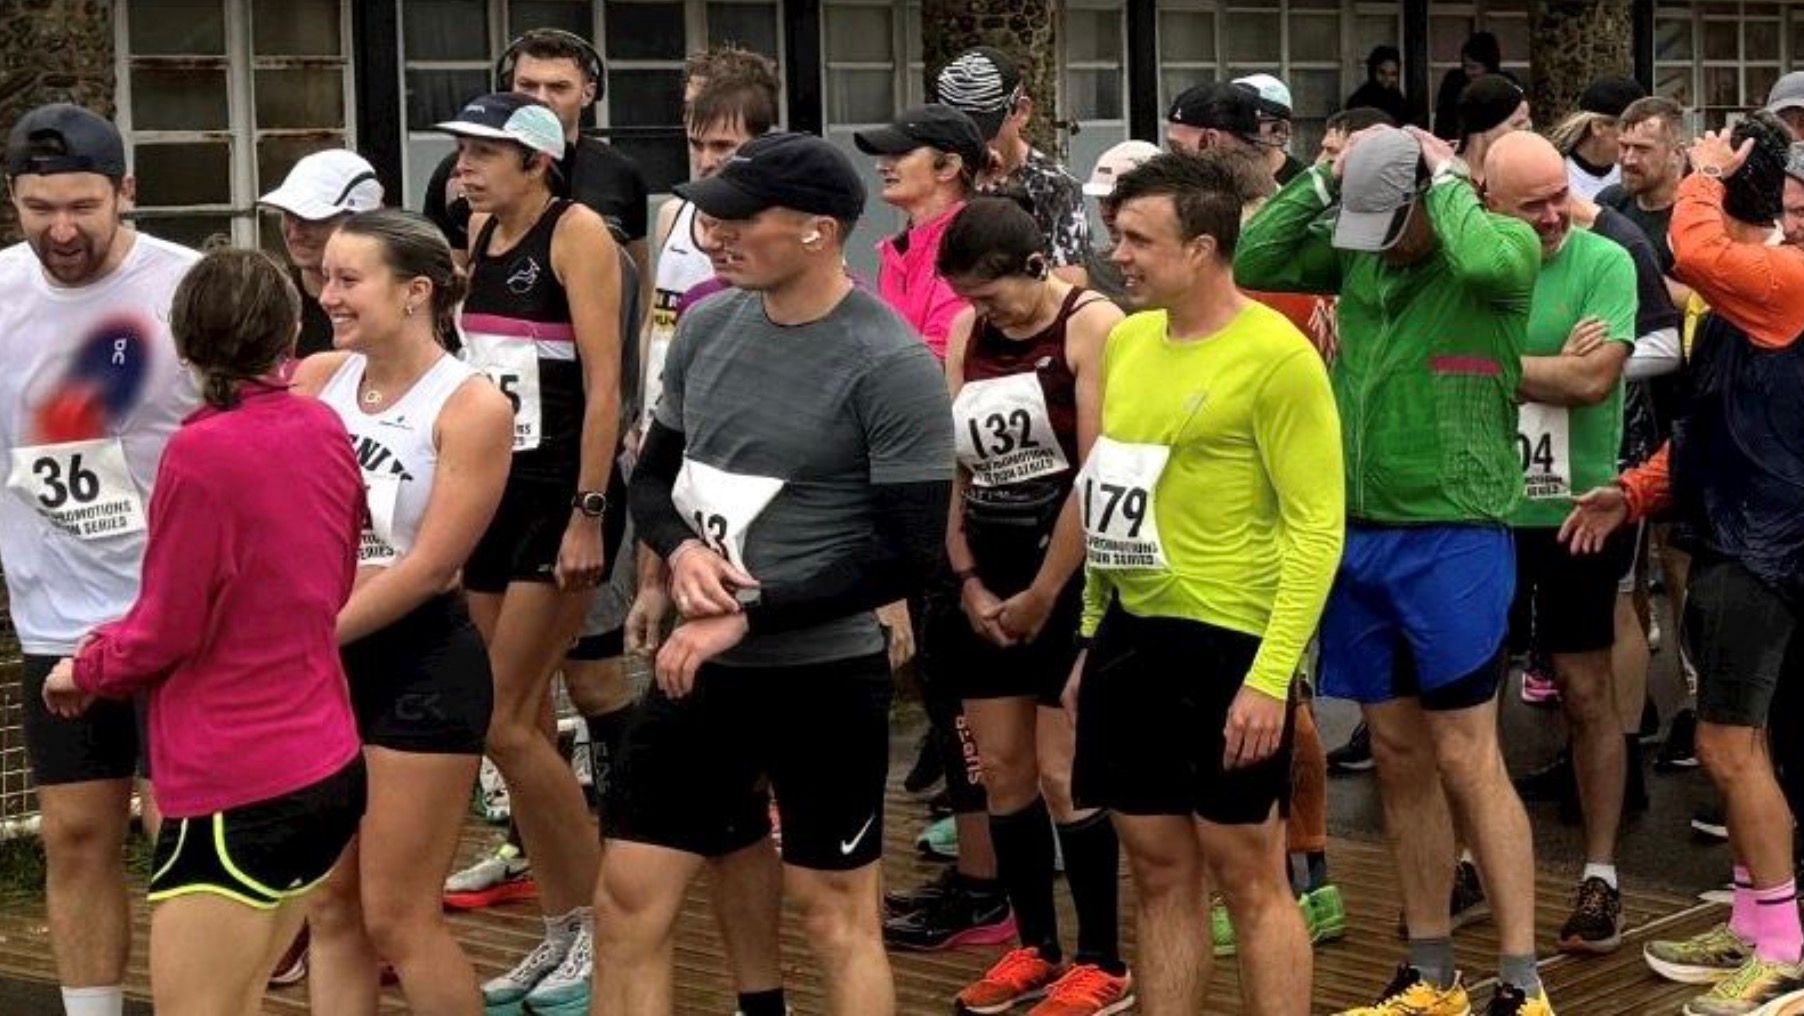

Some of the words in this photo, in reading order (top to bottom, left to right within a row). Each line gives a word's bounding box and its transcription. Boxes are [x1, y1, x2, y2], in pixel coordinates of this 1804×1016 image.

[968, 408, 1039, 460] 132
[32, 452, 100, 508] 36
[1084, 478, 1148, 537] 179
